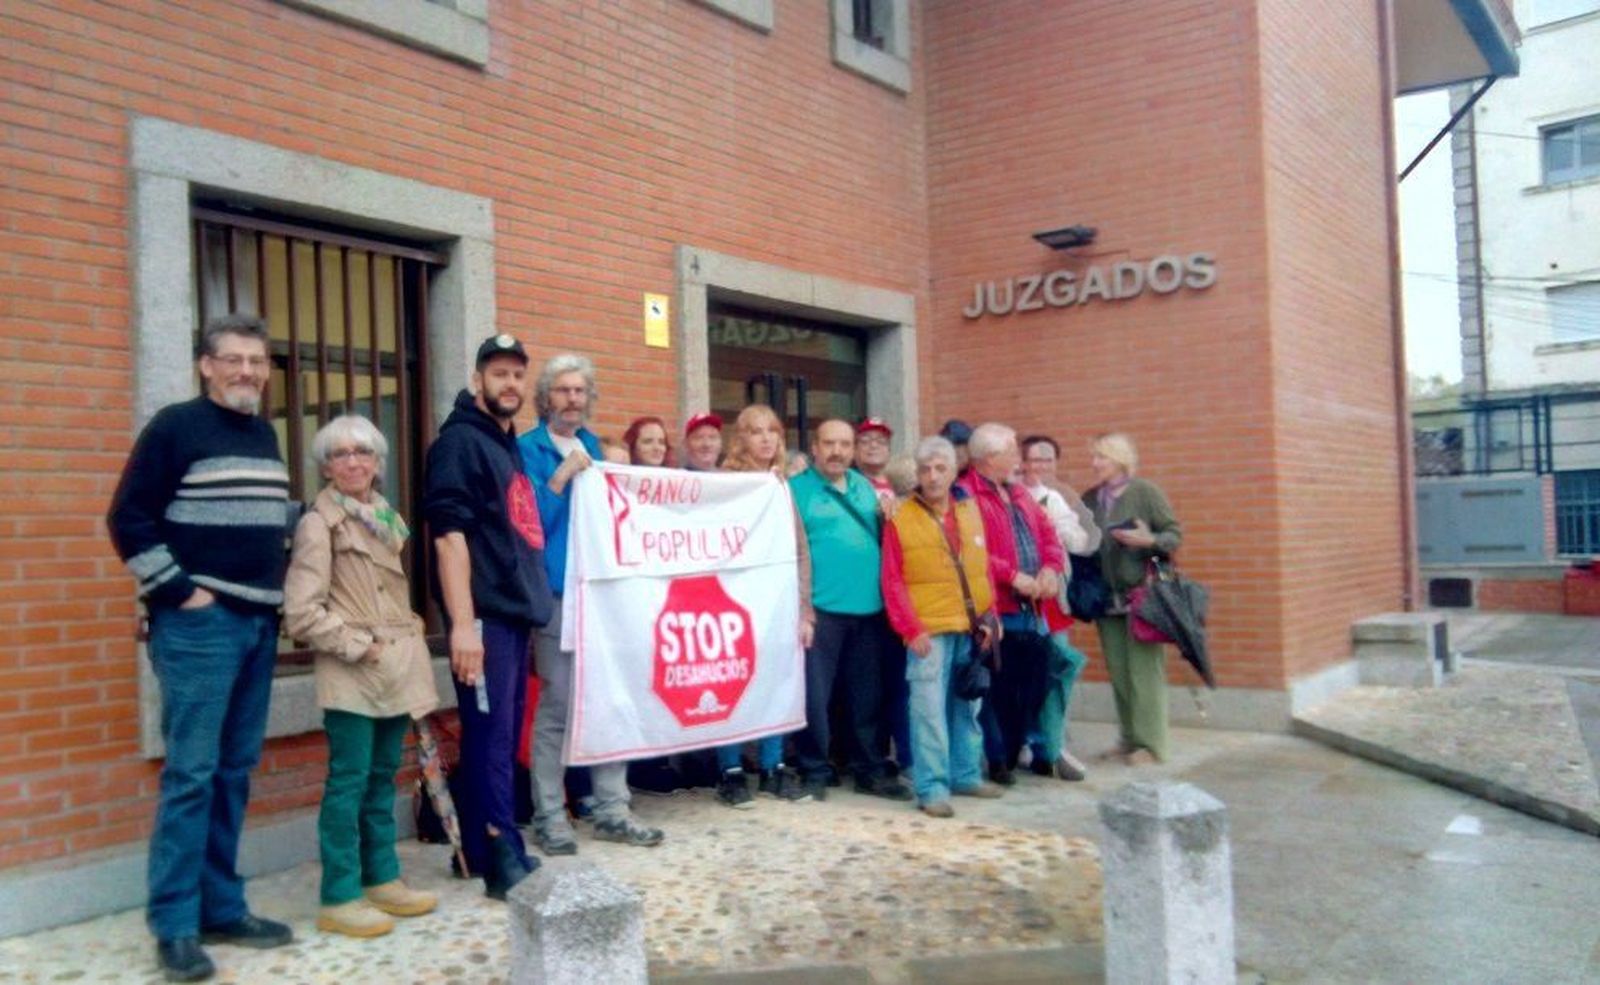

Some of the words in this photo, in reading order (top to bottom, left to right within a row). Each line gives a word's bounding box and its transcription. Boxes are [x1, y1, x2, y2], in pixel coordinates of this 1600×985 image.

[962, 252, 1218, 319] JUZGADOS
[637, 478, 702, 505] BANCO
[642, 526, 748, 562] POPULAR
[660, 611, 744, 663] STOP
